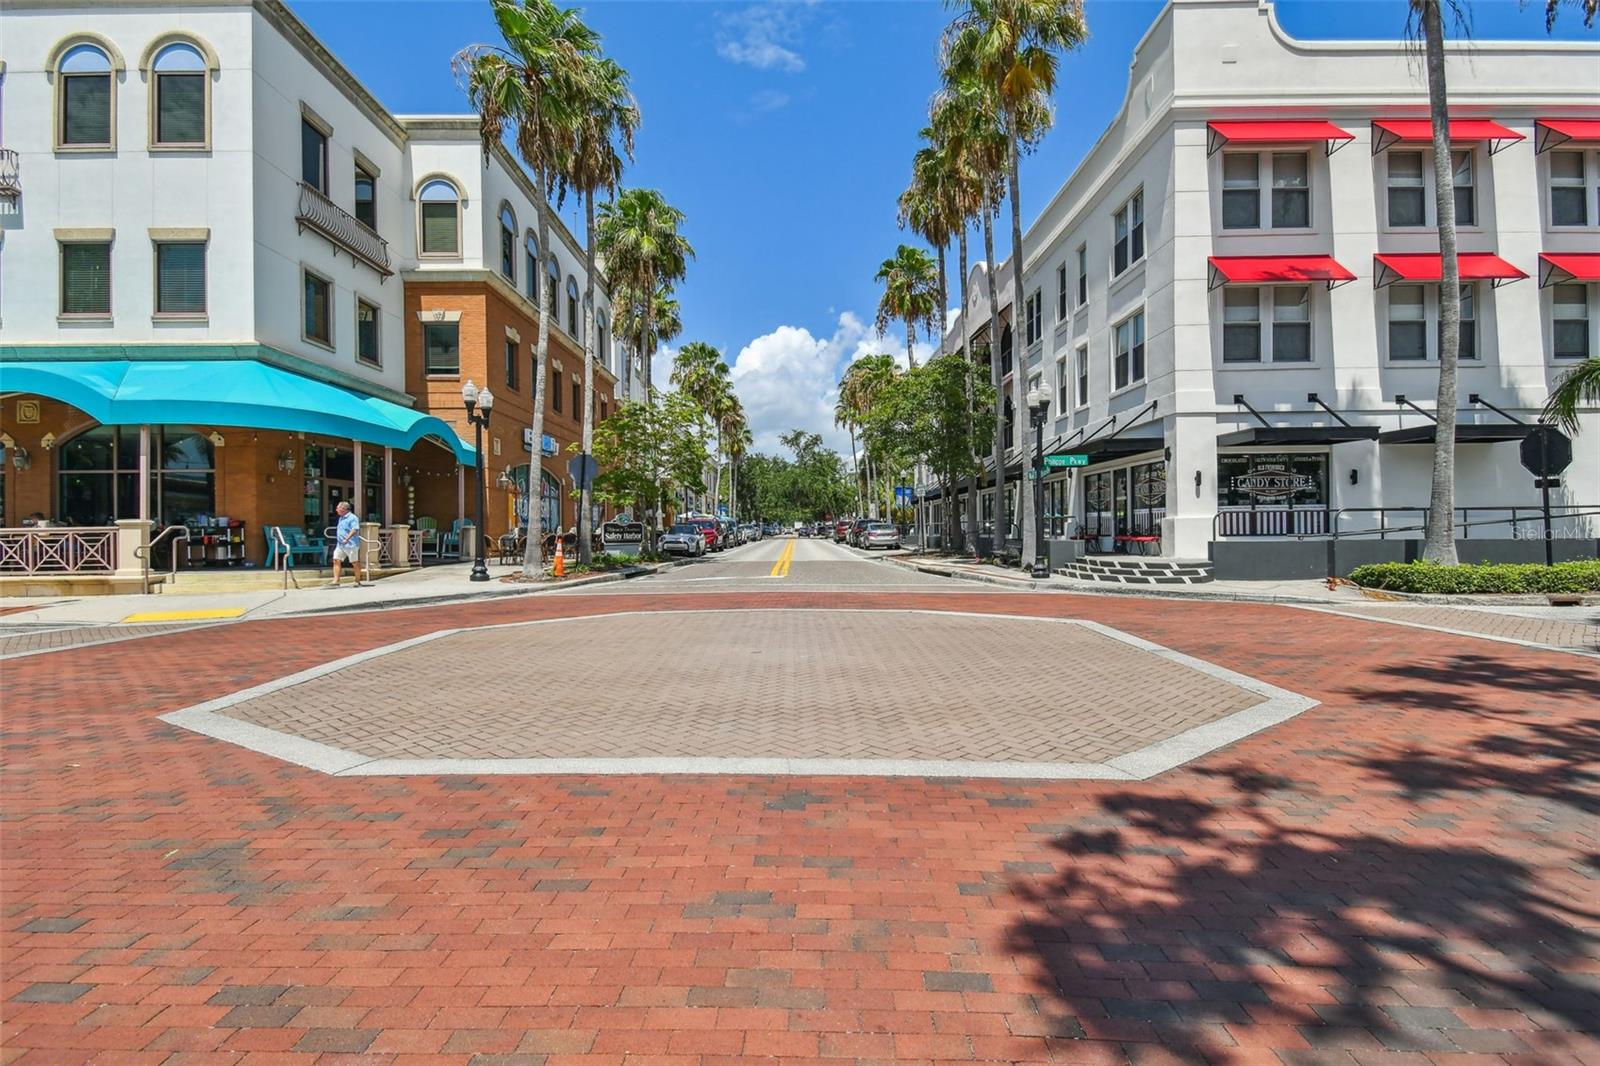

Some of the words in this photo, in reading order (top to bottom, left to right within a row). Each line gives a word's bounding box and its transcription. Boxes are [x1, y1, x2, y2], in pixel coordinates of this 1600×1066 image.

[1070, 456, 1087, 465] Pkwy
[1237, 477, 1271, 488] CANDY
[1274, 477, 1306, 488] STORE
[605, 532, 622, 541] Safety
[623, 532, 642, 540] Harbor
